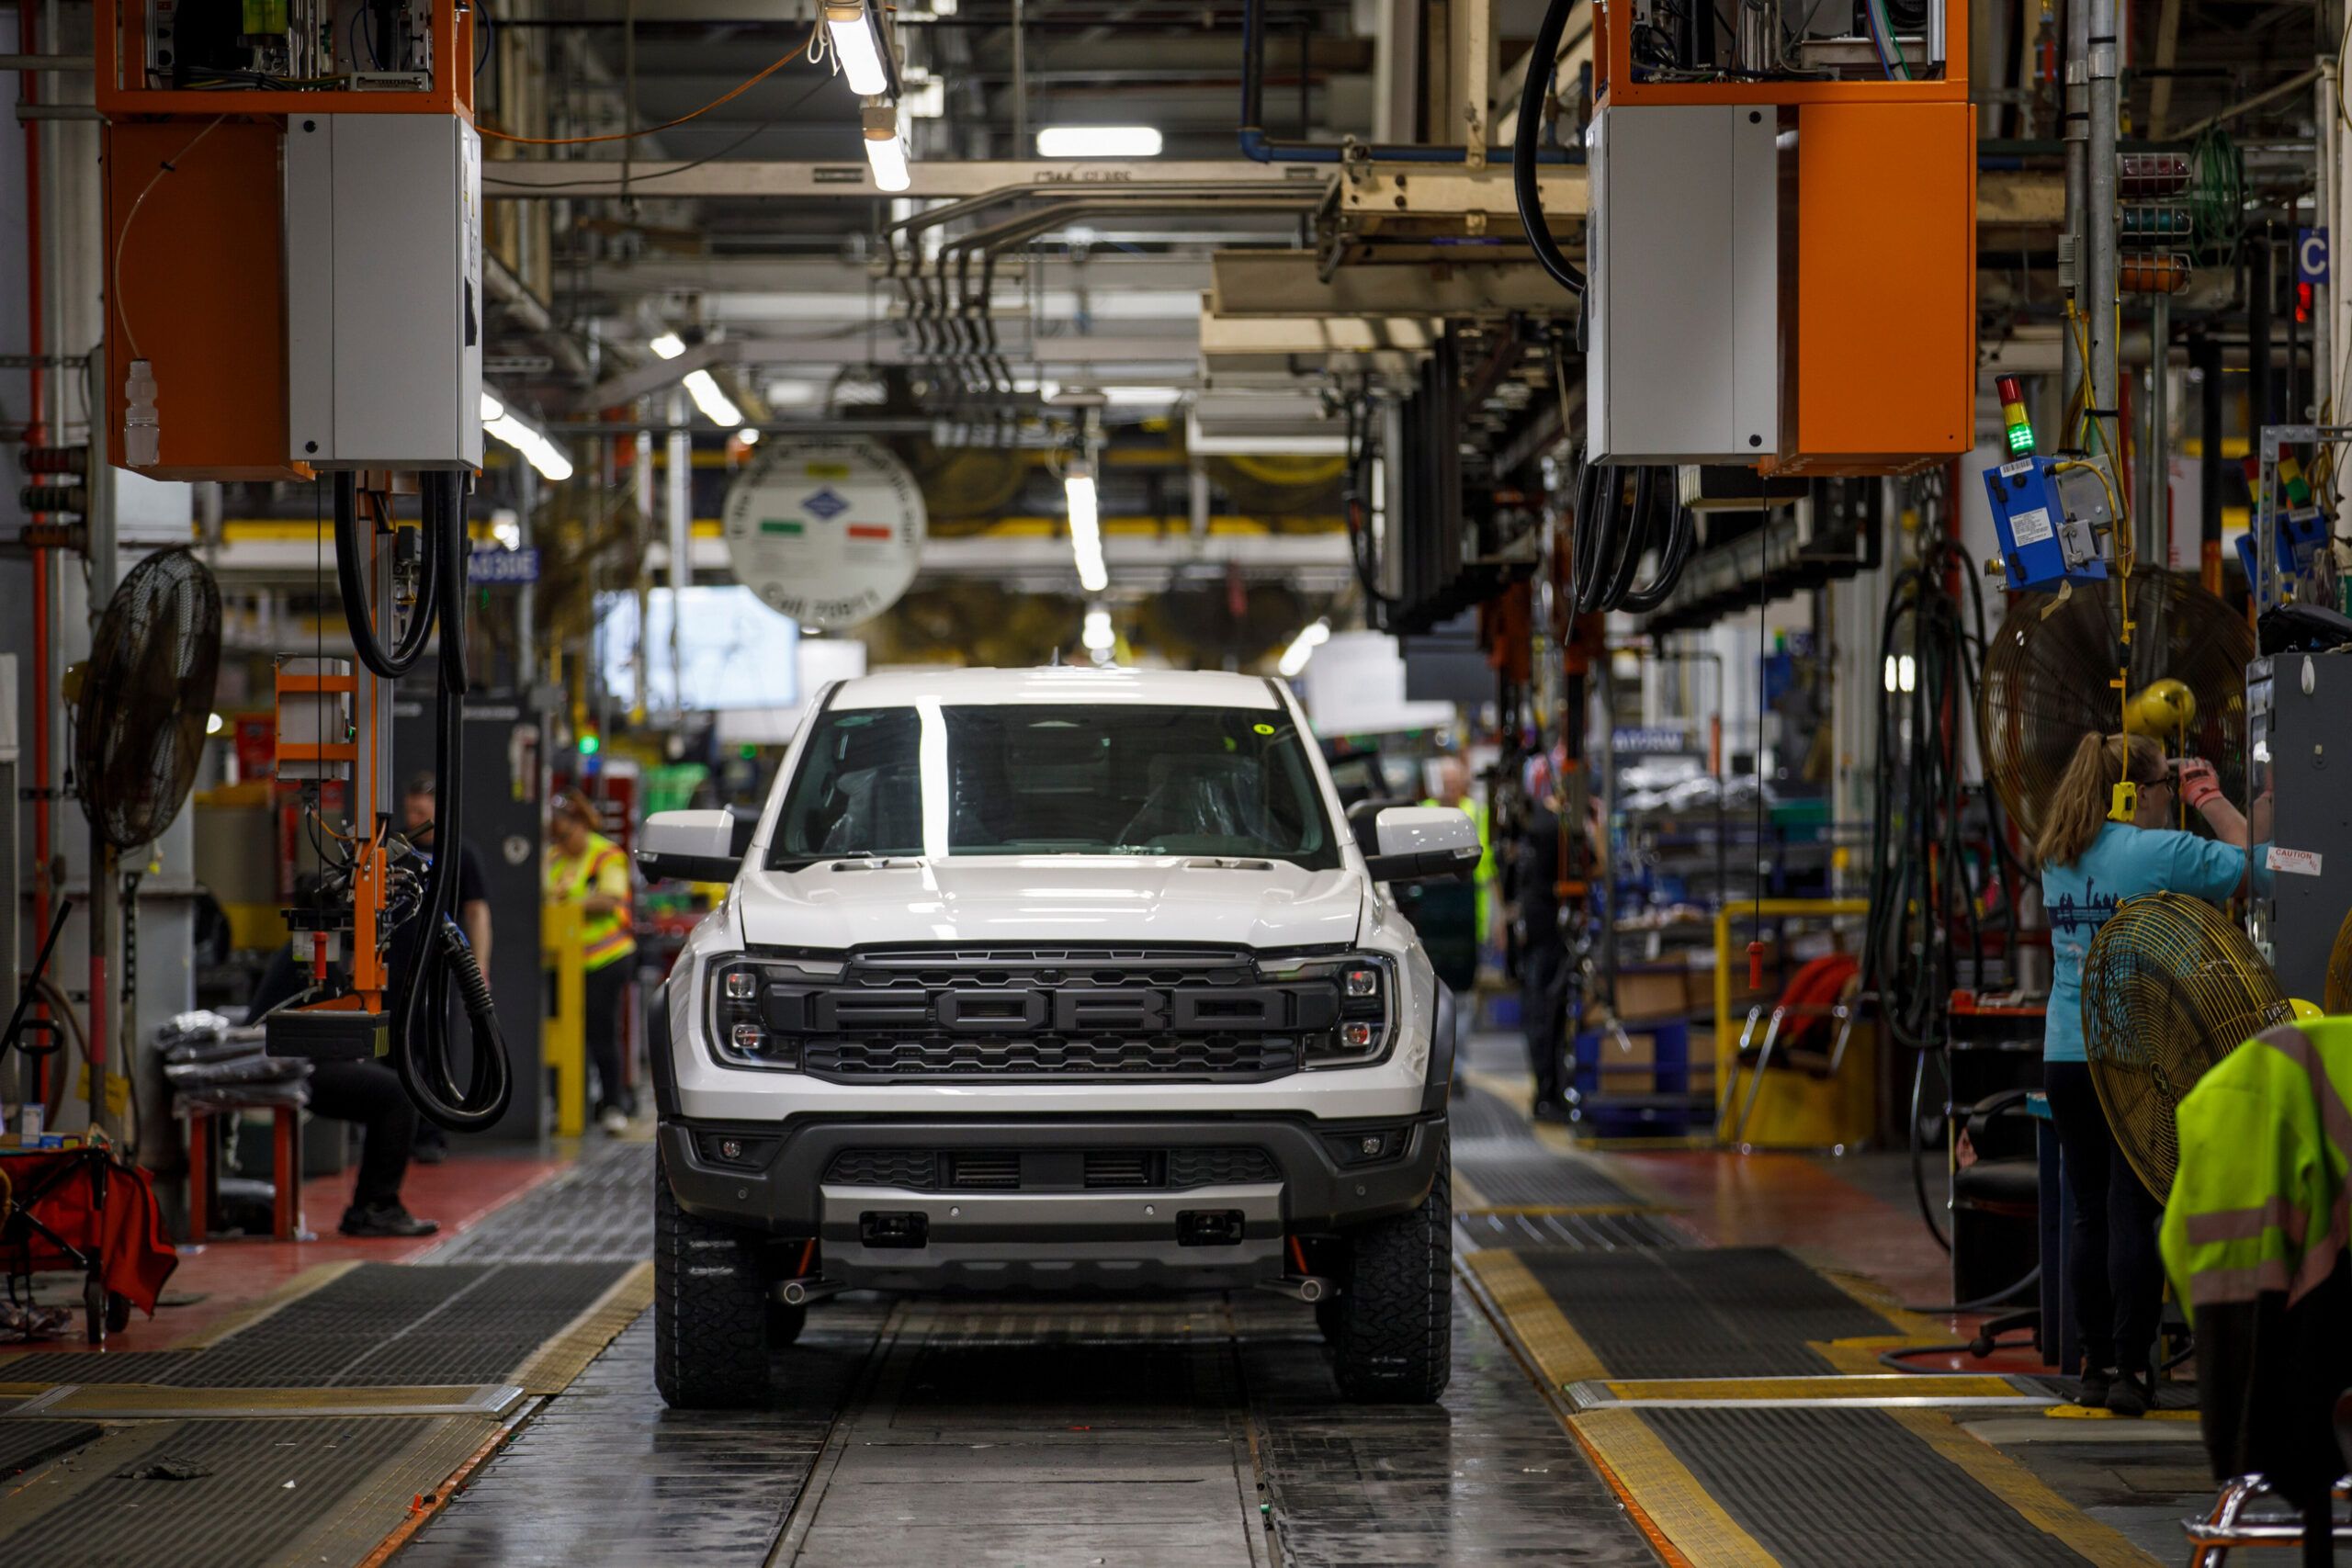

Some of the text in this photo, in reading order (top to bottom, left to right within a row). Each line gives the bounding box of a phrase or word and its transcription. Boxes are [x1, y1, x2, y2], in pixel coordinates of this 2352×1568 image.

[2301, 237, 2326, 276] C
[2276, 849, 2312, 860] CAUTION
[815, 987, 1284, 1031] FORD
